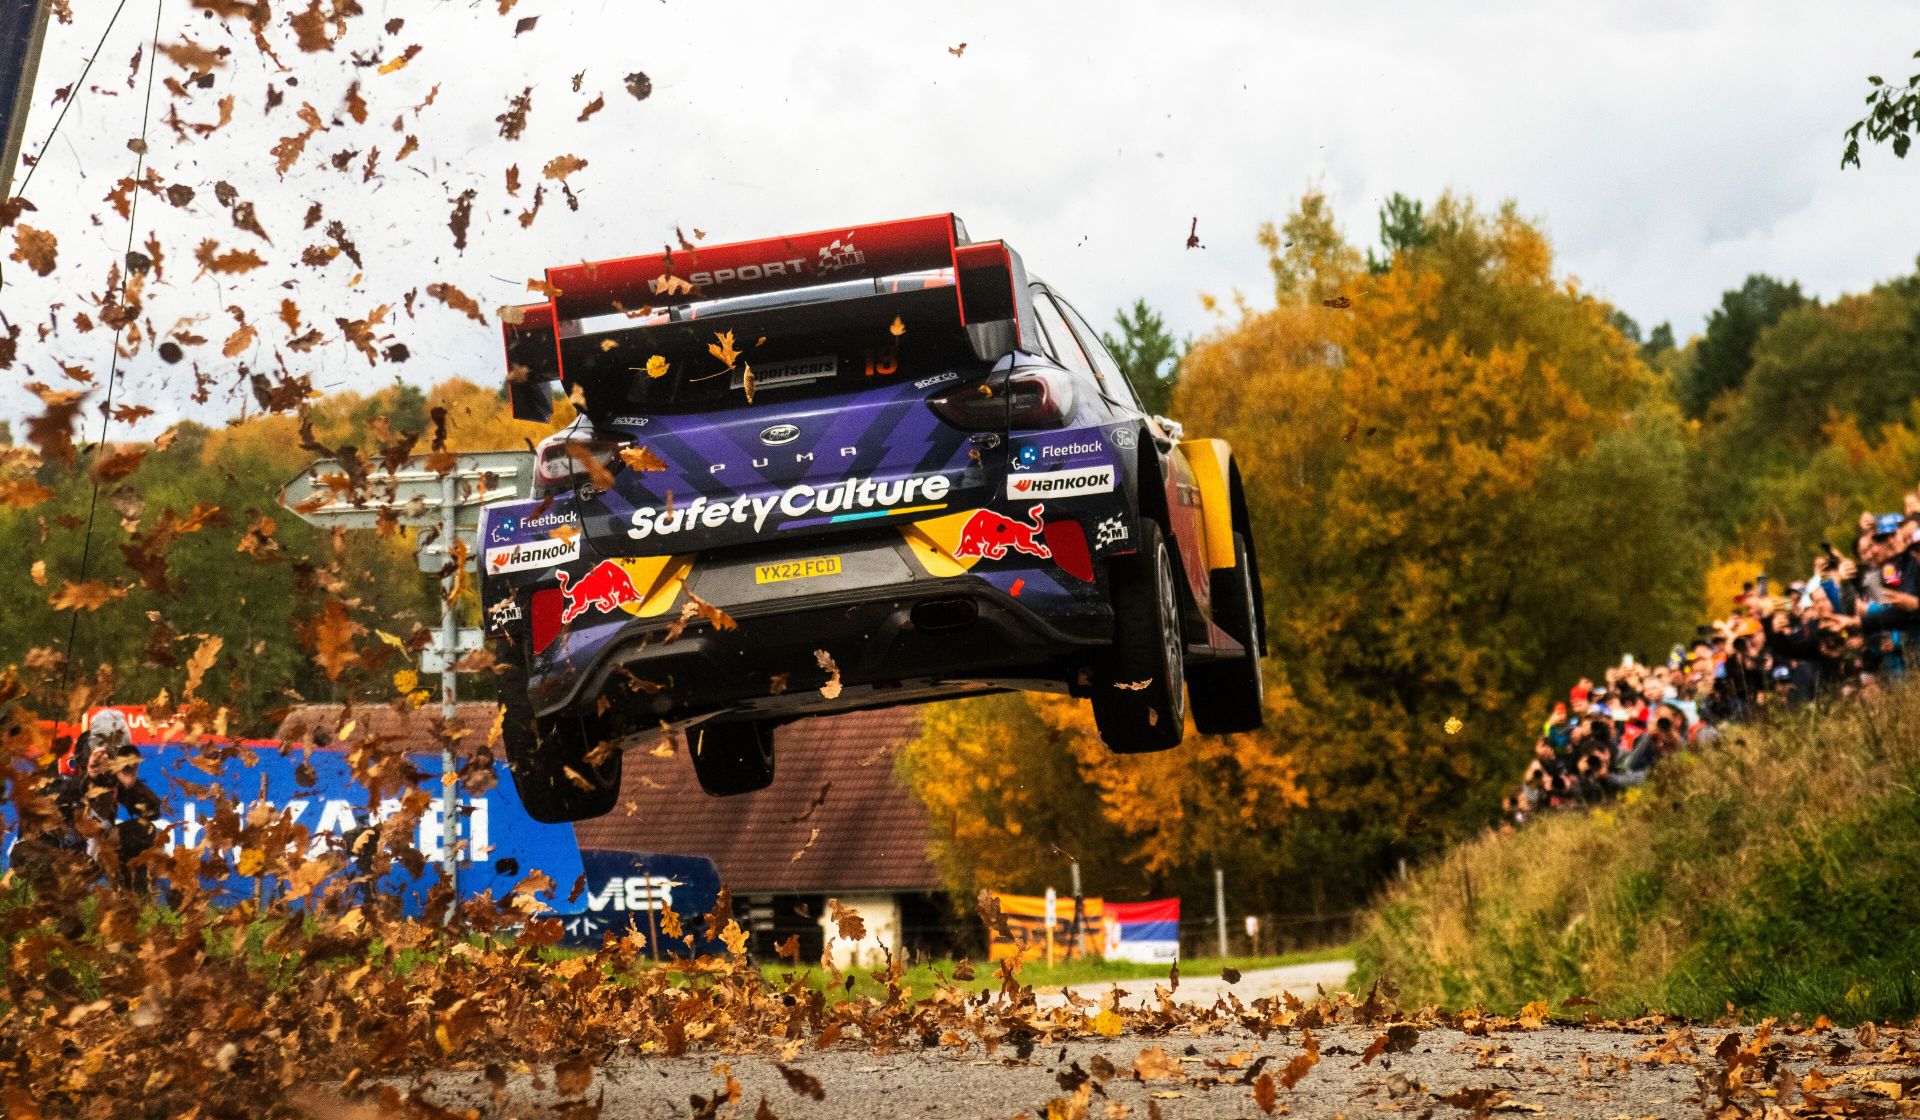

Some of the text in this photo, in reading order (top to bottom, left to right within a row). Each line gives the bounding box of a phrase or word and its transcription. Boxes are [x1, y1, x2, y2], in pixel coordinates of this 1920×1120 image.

[710, 446, 857, 474] PUMA
[1042, 440, 1103, 458] Fleetback
[627, 474, 950, 540] SafetyCulture
[520, 510, 577, 529] Fleetback
[761, 558, 836, 580] YX22 FCD
